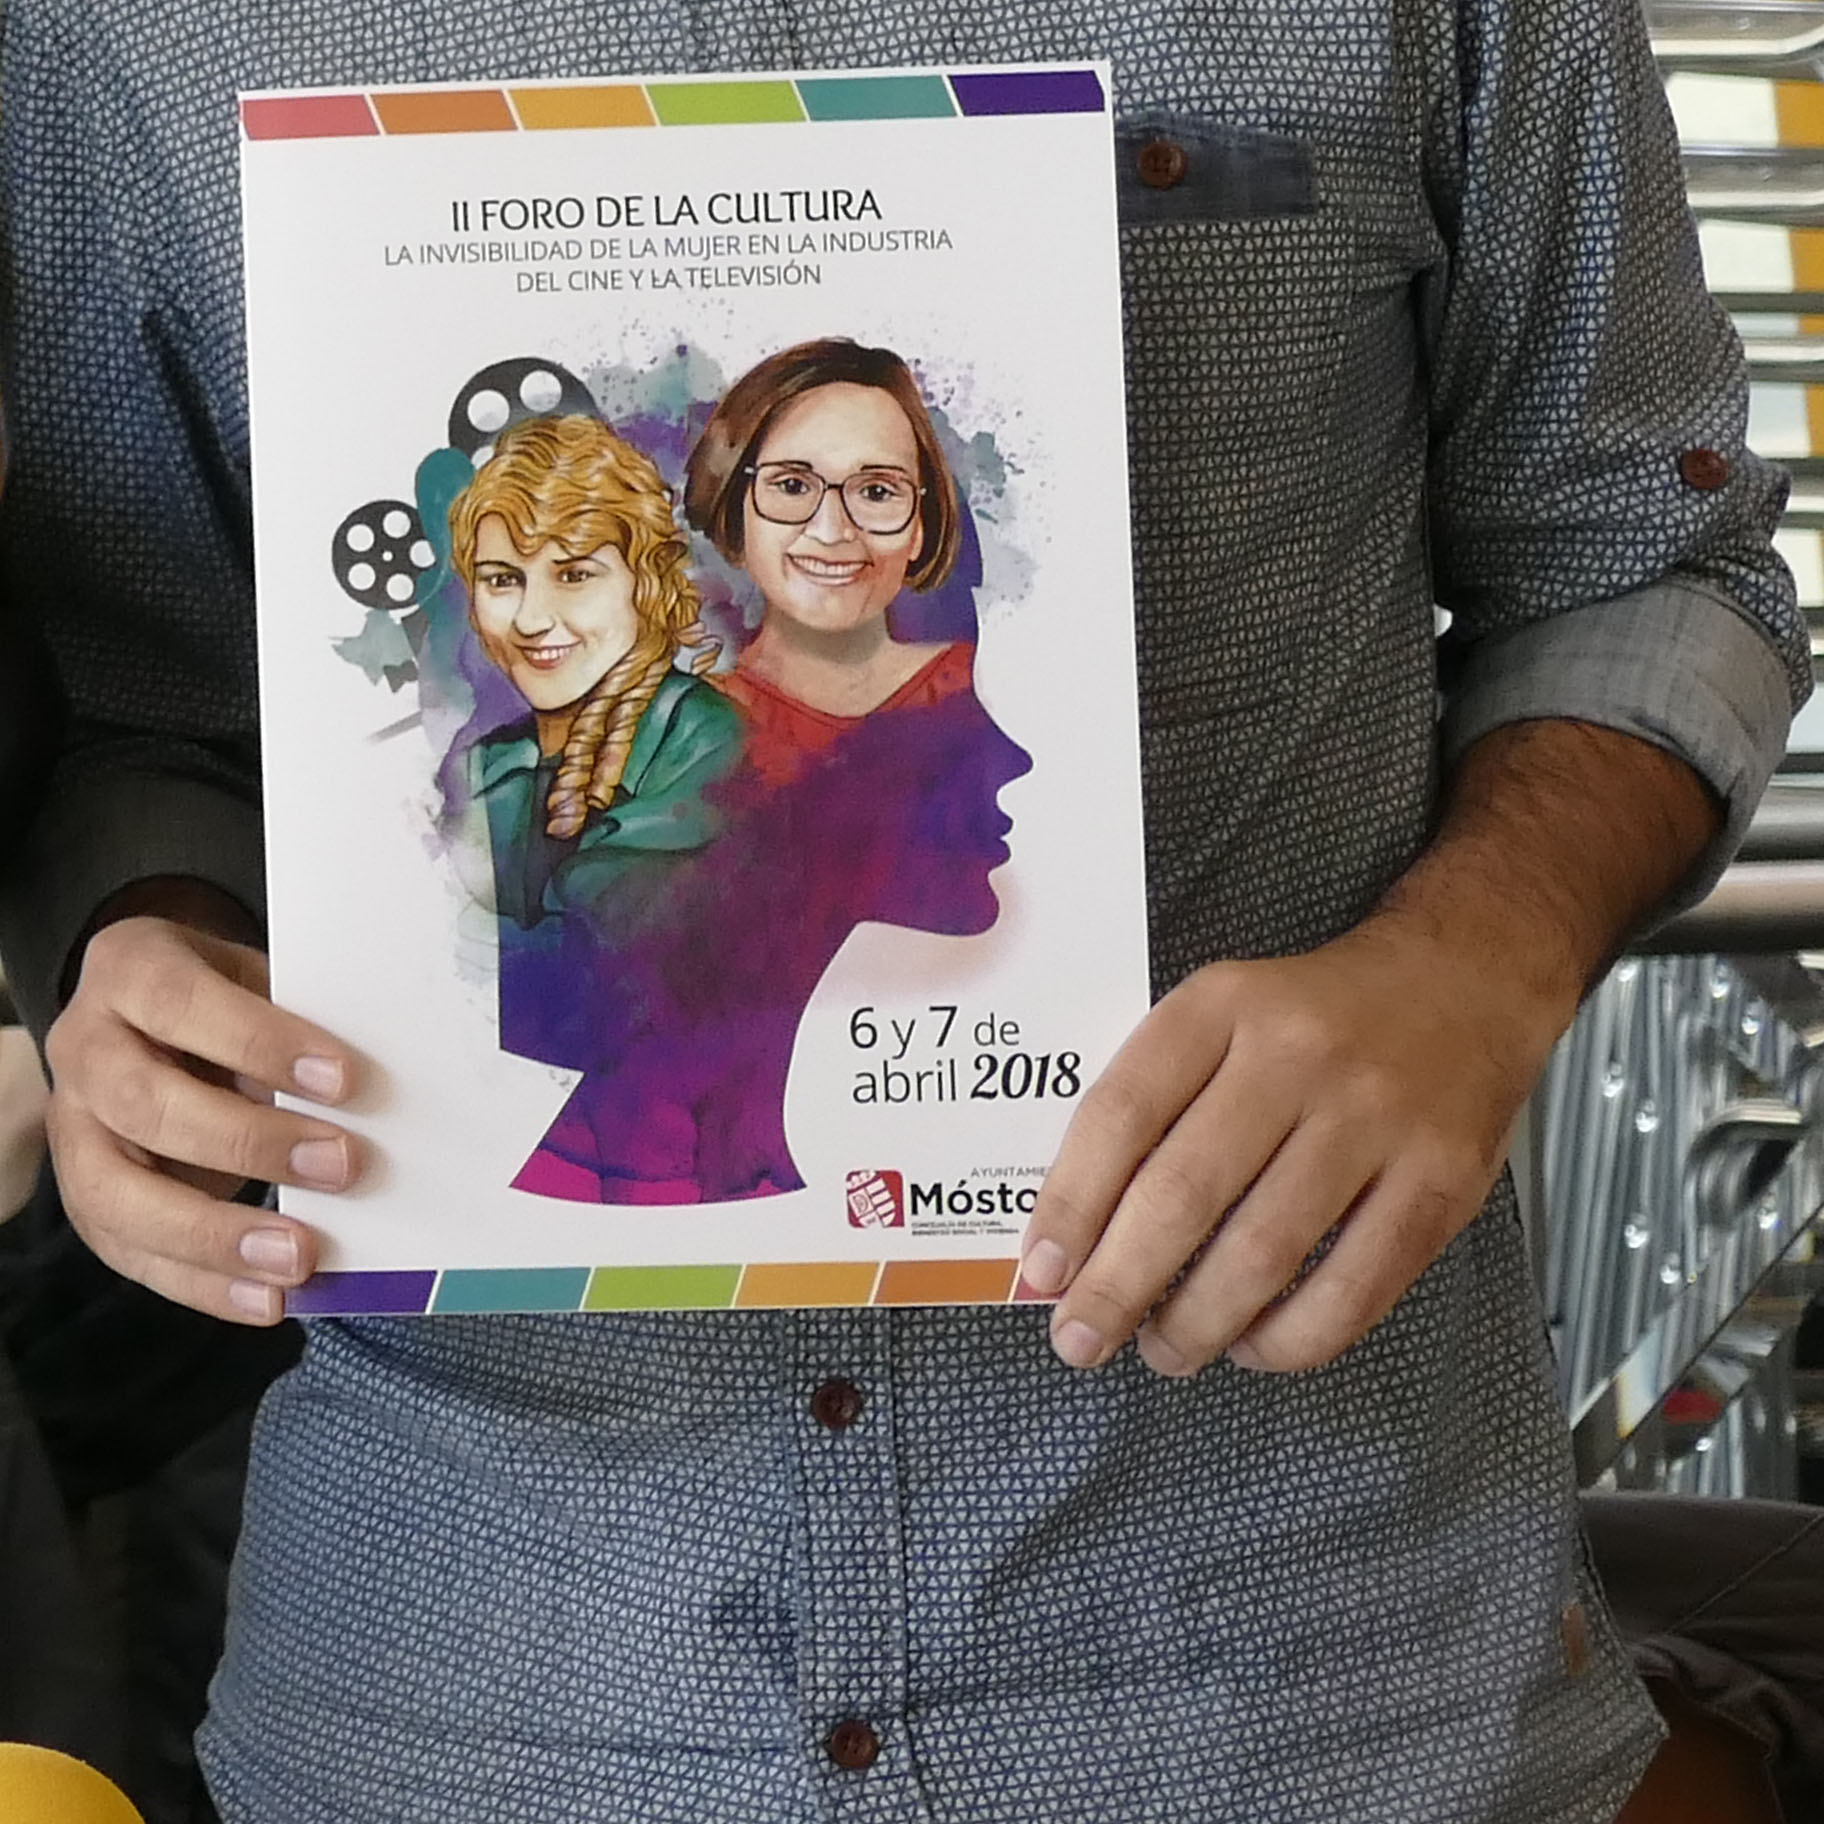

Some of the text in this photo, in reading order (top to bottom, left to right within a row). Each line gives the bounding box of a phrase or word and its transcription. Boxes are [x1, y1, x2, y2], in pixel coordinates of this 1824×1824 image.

[452, 189, 883, 231] II FORO DE LA CULTURA
[385, 229, 953, 266] LA INVISIBILIDAD DE LA MUJER EN LA INDUSTRIA
[517, 260, 821, 292] DEL CINE Y LA TELEVISIÓN
[850, 1005, 1020, 1060] 6 y 7 de
[852, 1051, 1081, 1104] abril 2018
[970, 1165, 1053, 1177] AYUNTAMIE
[910, 1180, 1039, 1216] Mósto
